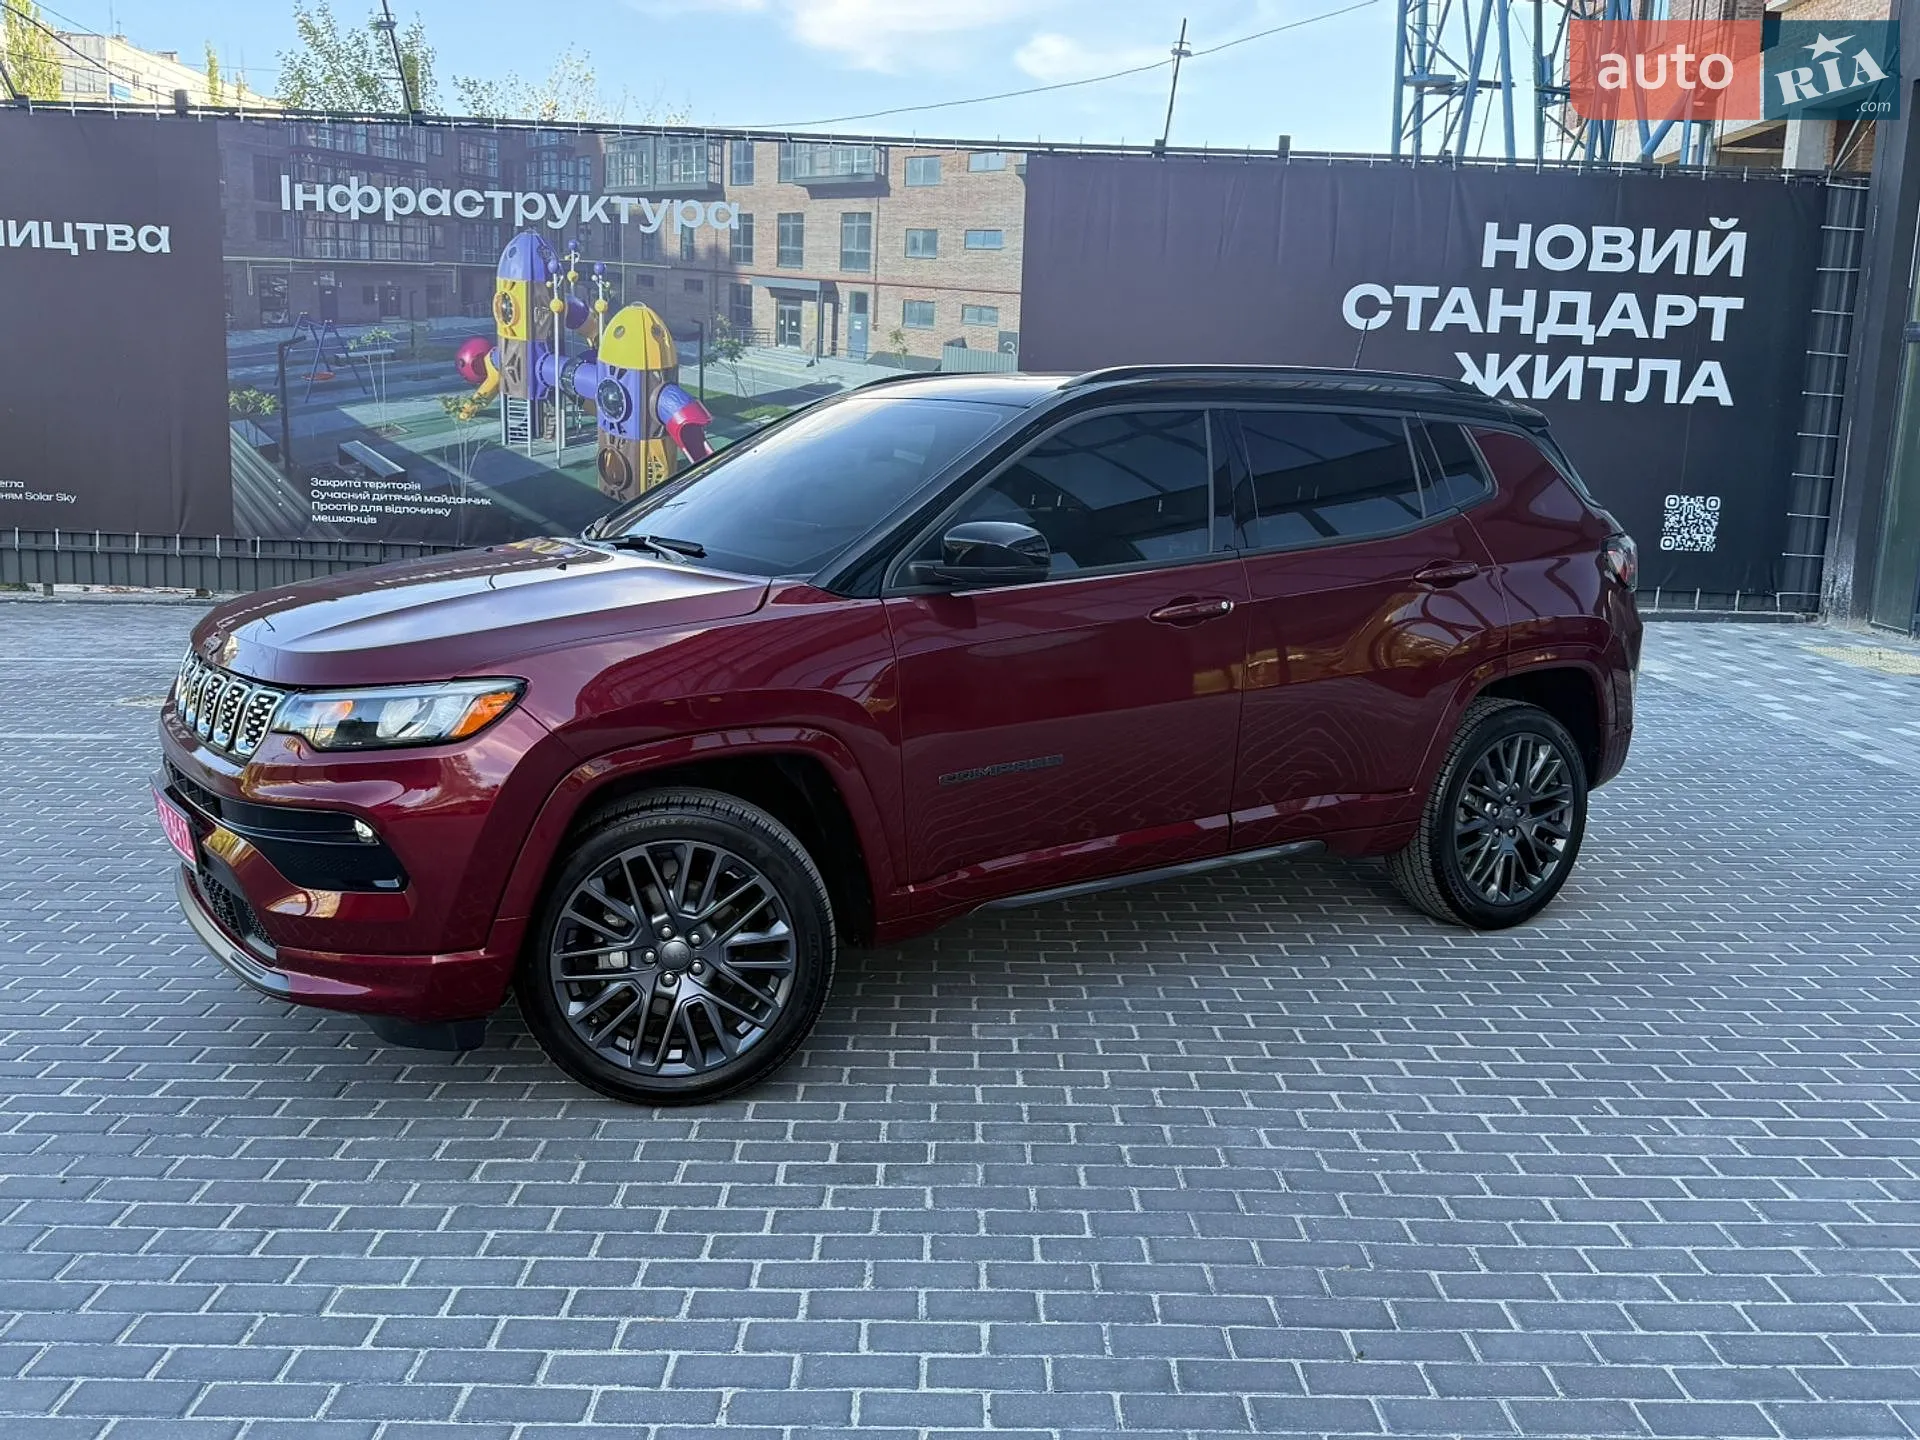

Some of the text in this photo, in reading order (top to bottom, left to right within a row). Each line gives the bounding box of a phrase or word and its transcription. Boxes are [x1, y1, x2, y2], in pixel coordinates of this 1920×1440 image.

[279, 174, 741, 234] Інфраструктура
[0, 219, 171, 256] ицтва
[1481, 217, 1748, 278] НОВИЙ
[1342, 282, 1745, 346] СТАНДАРТ
[1454, 351, 1734, 406] ЖИТЛА
[0, 492, 77, 503] ням Solar Sky
[310, 477, 421, 491] Закрита територія
[310, 489, 492, 506] Сучасний дитячий майданчик
[311, 501, 452, 517] Простір для відпочинку
[311, 514, 377, 524] мешканців
